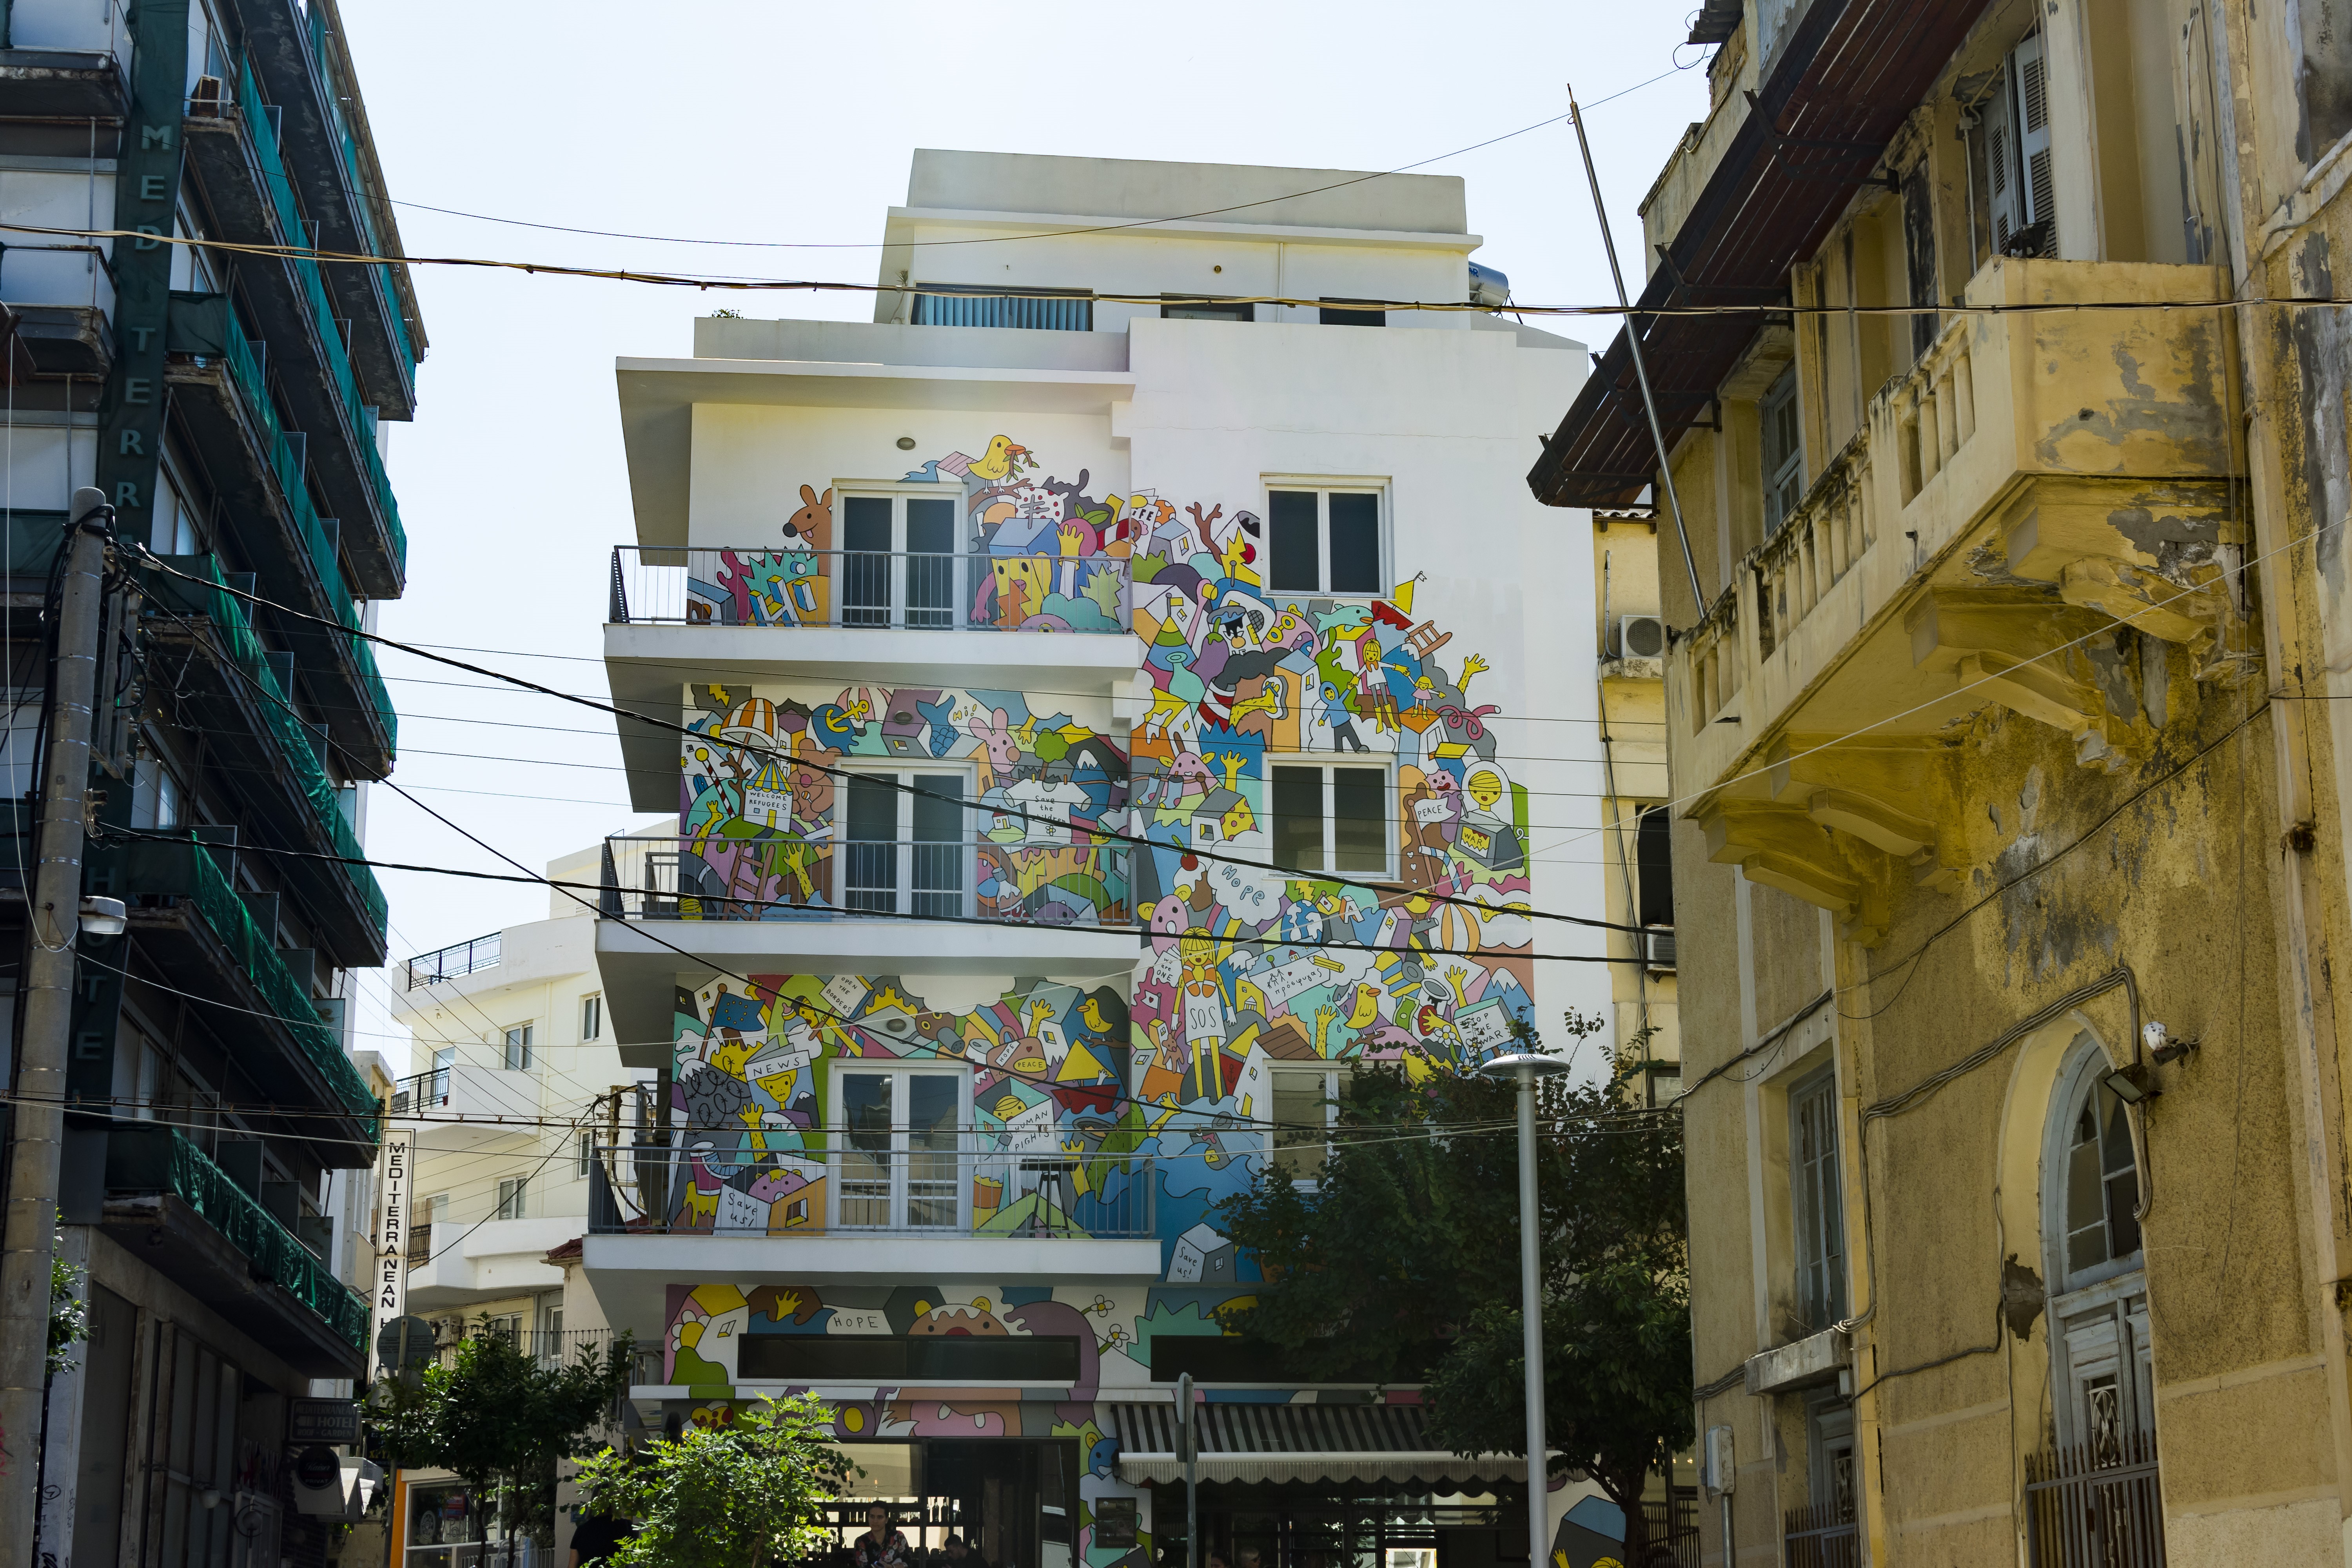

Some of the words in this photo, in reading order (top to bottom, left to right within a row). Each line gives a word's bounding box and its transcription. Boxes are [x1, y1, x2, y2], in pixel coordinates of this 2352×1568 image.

[750, 792, 787, 801] WELCOME
[1035, 795, 1055, 804] Save
[749, 799, 787, 811] REFUGEES
[1417, 805, 1443, 819] PEACE
[1464, 832, 1483, 846] WAR
[1157, 969, 1173, 981] ONE
[839, 985, 850, 995] THE
[841, 977, 857, 989] OPEN
[826, 988, 851, 1013] BORDERS
[1190, 1006, 1216, 1029] SOS
[1480, 1030, 1503, 1045] WAR
[999, 1043, 1014, 1062] HOPE
[753, 1057, 800, 1077] NEWS
[1015, 1110, 1047, 1134] HUMAN
[728, 1192, 758, 1216] Save
[381, 1142, 405, 1308] MEDITERRANEAN
[1179, 1246, 1197, 1267] Save
[1177, 1267, 1192, 1279] us!
[833, 1316, 878, 1328] HOPE
[296, 1405, 356, 1415] MEDITERRANEAN
[317, 1416, 355, 1428] HOTEL
